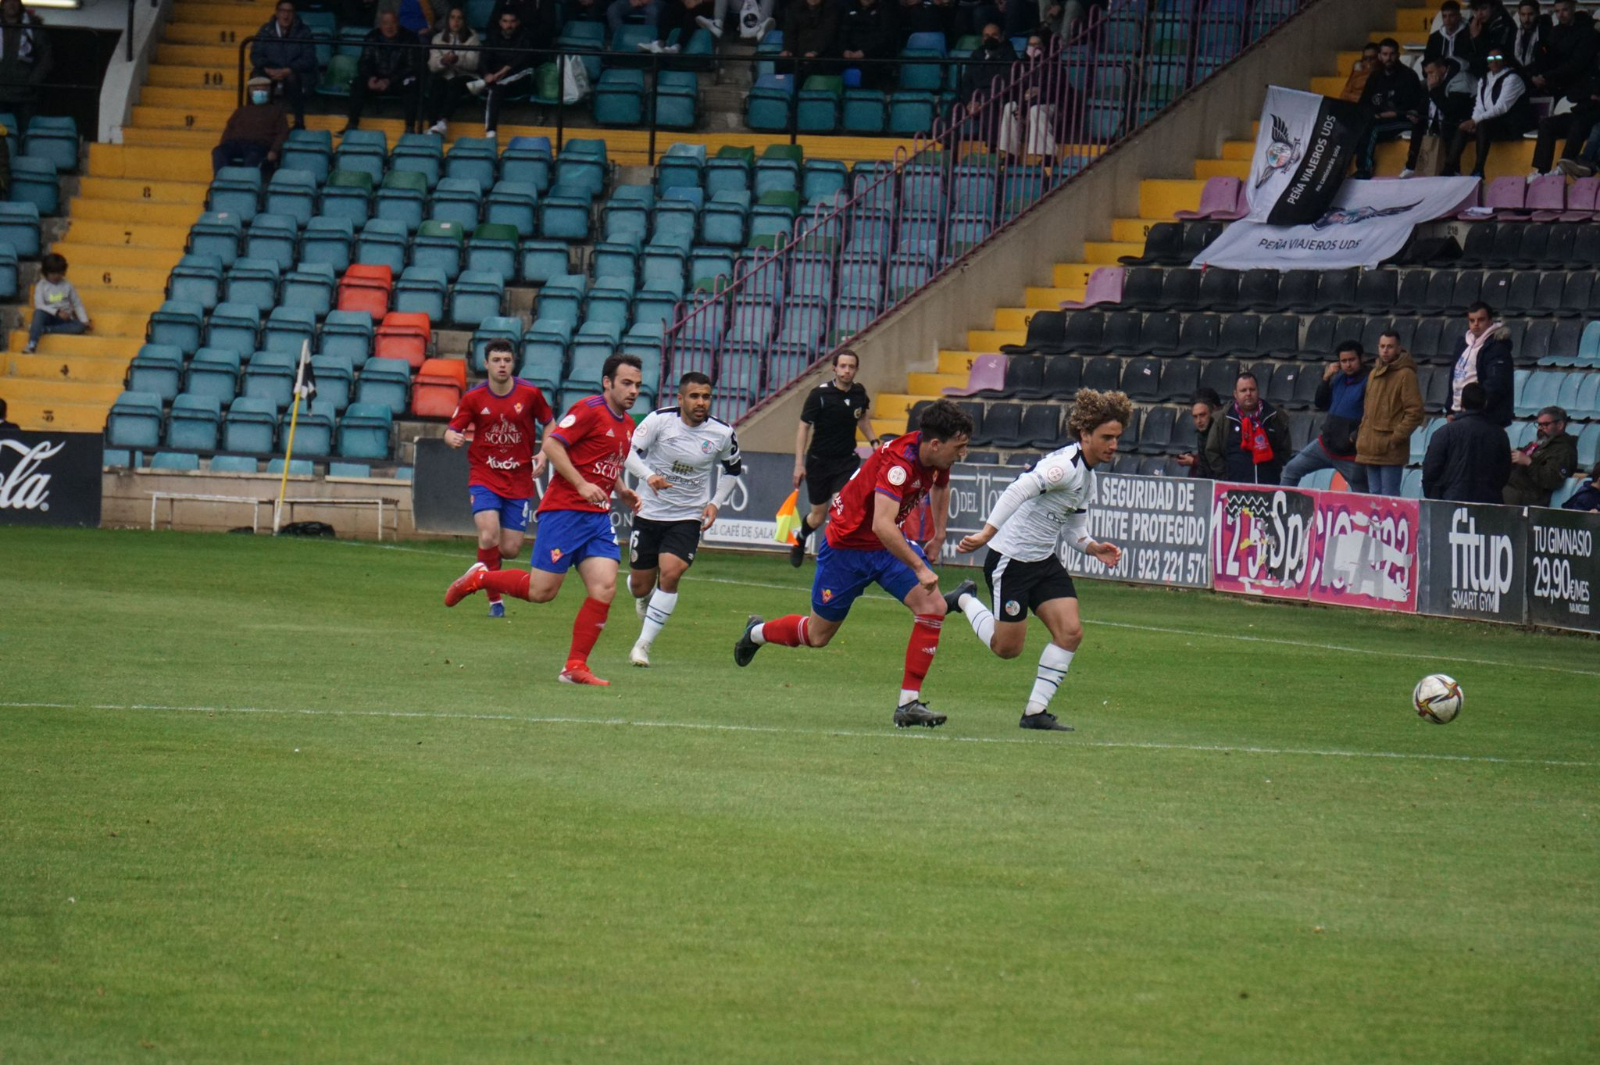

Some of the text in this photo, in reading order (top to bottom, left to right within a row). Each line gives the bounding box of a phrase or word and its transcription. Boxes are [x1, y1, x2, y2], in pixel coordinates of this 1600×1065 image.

[220, 31, 236, 43] 11
[203, 72, 223, 85] 10
[185, 115, 195, 127] 9
[1287, 114, 1336, 205] PEÑA VIAJEROS UDS
[143, 186, 151, 198] 8
[124, 231, 132, 244] 7
[1258, 238, 1362, 251] PEÑA VIAJEROS UDS
[102, 272, 112, 284] 6
[60, 364, 69, 376] 4
[485, 432, 522, 444] SCONE
[0, 439, 65, 509] la
[960, 492, 978, 513] DEL
[1102, 477, 1174, 511] SEGURIDAD
[1177, 483, 1195, 512] DE
[719, 522, 740, 537] CAFÉ
[741, 526, 752, 538] DE
[1086, 508, 1206, 546] NTIRTE PROTEGIDO
[1533, 525, 1592, 557] TU GIMNASIO
[1138, 549, 1160, 580] 923
[1162, 551, 1184, 582] 221
[1187, 553, 1207, 584] 571
[1449, 507, 1513, 613] fitup
[1451, 590, 1495, 612] SMART GYM
